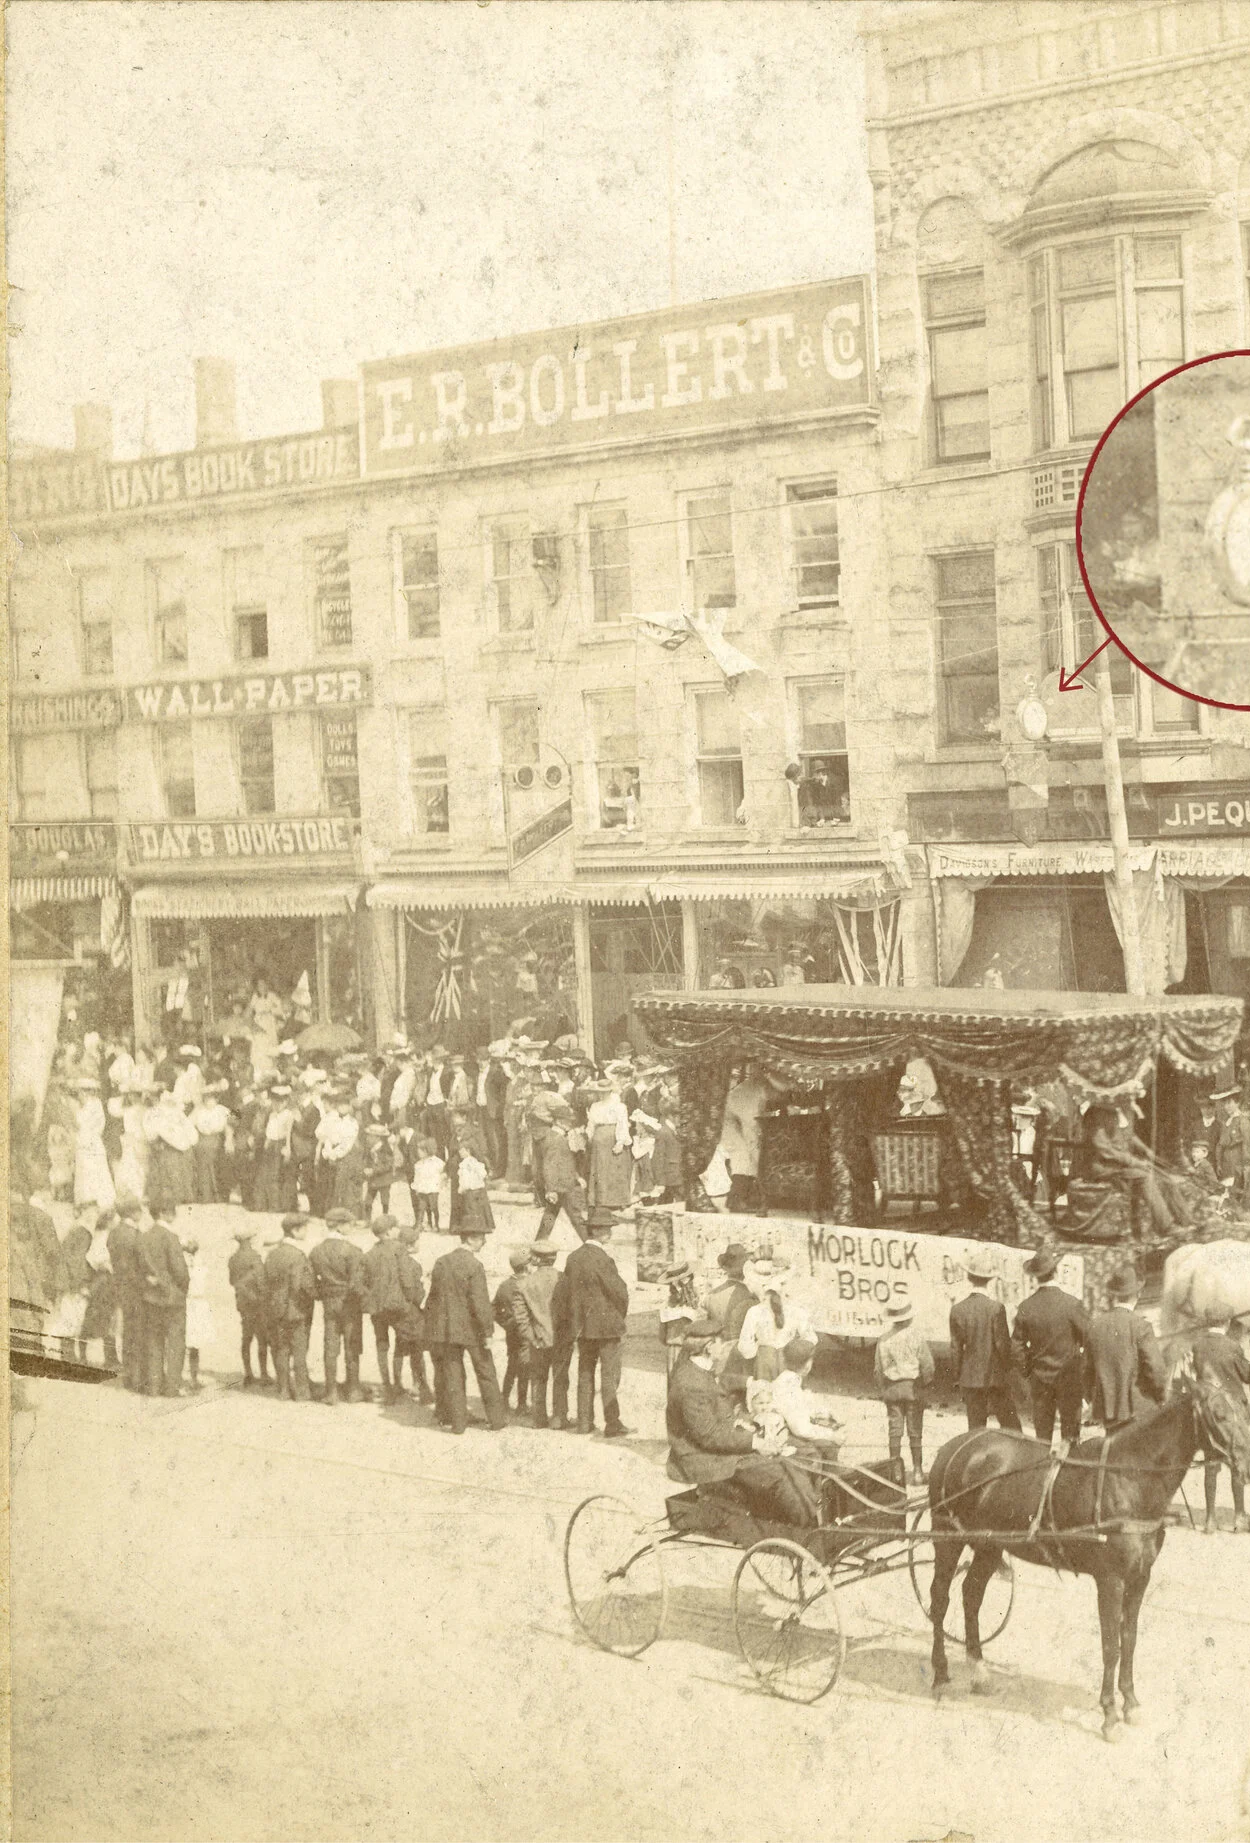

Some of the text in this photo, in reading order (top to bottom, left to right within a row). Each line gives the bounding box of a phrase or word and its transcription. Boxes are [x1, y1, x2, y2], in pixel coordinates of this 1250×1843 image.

[797, 328, 817, 378] &
[184, 452, 257, 497] BOOK
[264, 433, 357, 484] STORE
[134, 682, 234, 717] WALL
[140, 825, 214, 859] DAY'S
[1008, 852, 1061, 868] FURNITURE
[808, 1225, 921, 1277] MORLOCK
